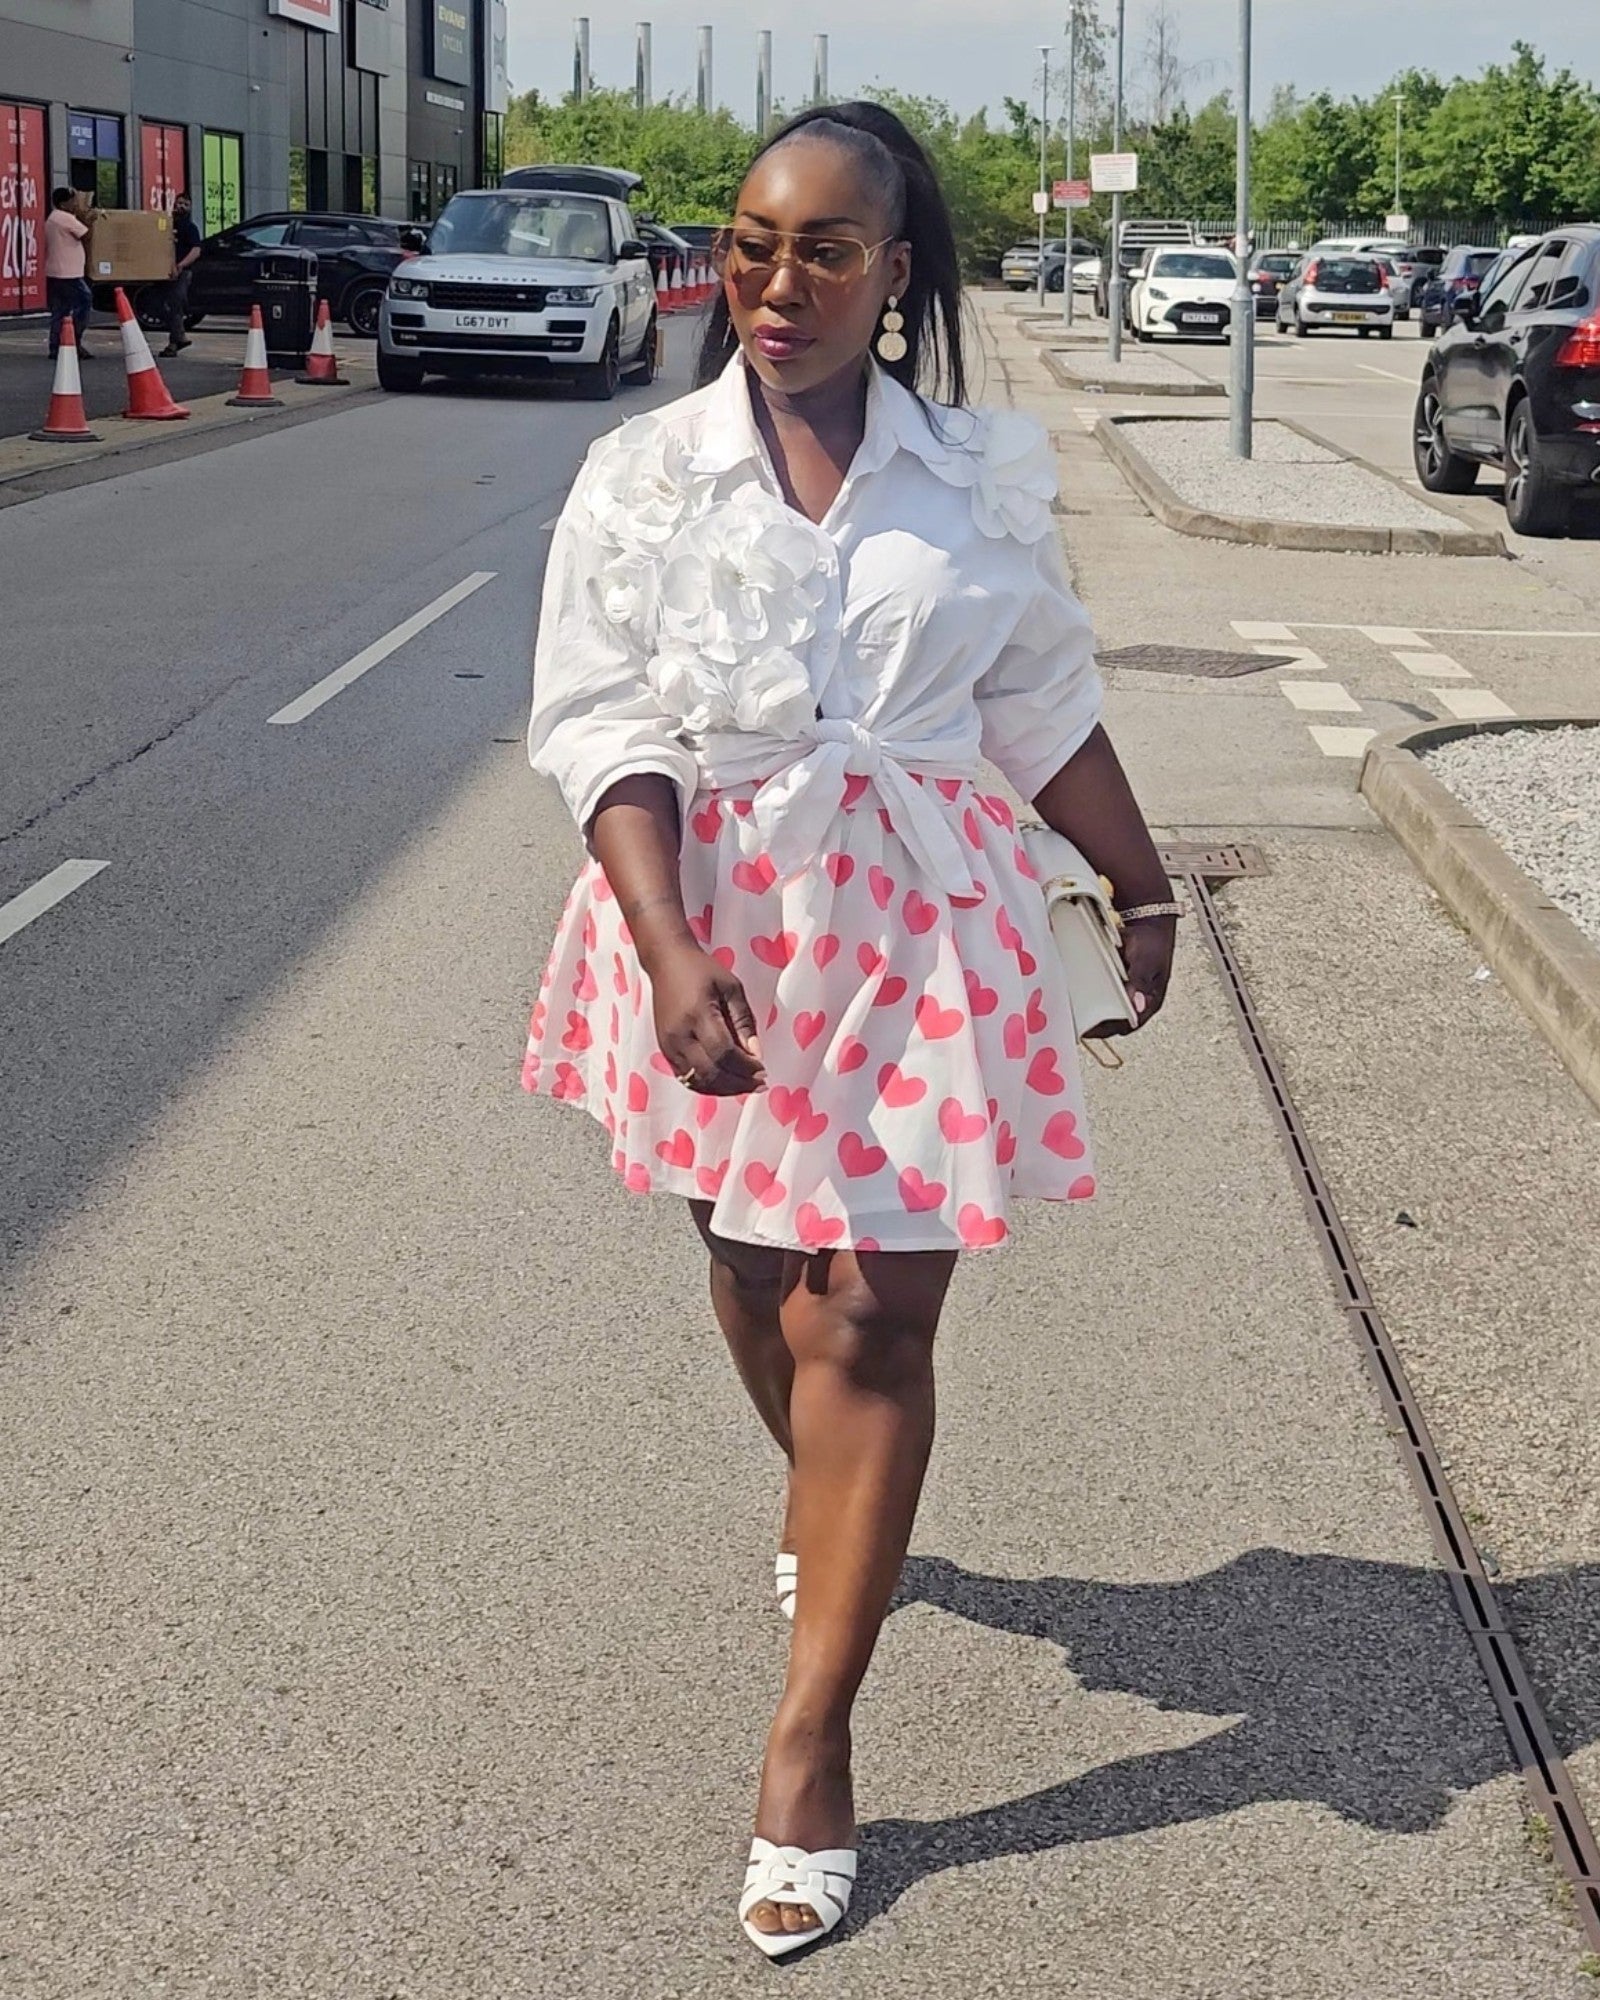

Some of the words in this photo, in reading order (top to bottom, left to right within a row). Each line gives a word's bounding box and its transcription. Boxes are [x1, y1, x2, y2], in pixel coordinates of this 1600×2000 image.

[438, 5, 465, 30] EVANS
[456, 316, 485, 327] LG67
[488, 318, 509, 328] DVT
